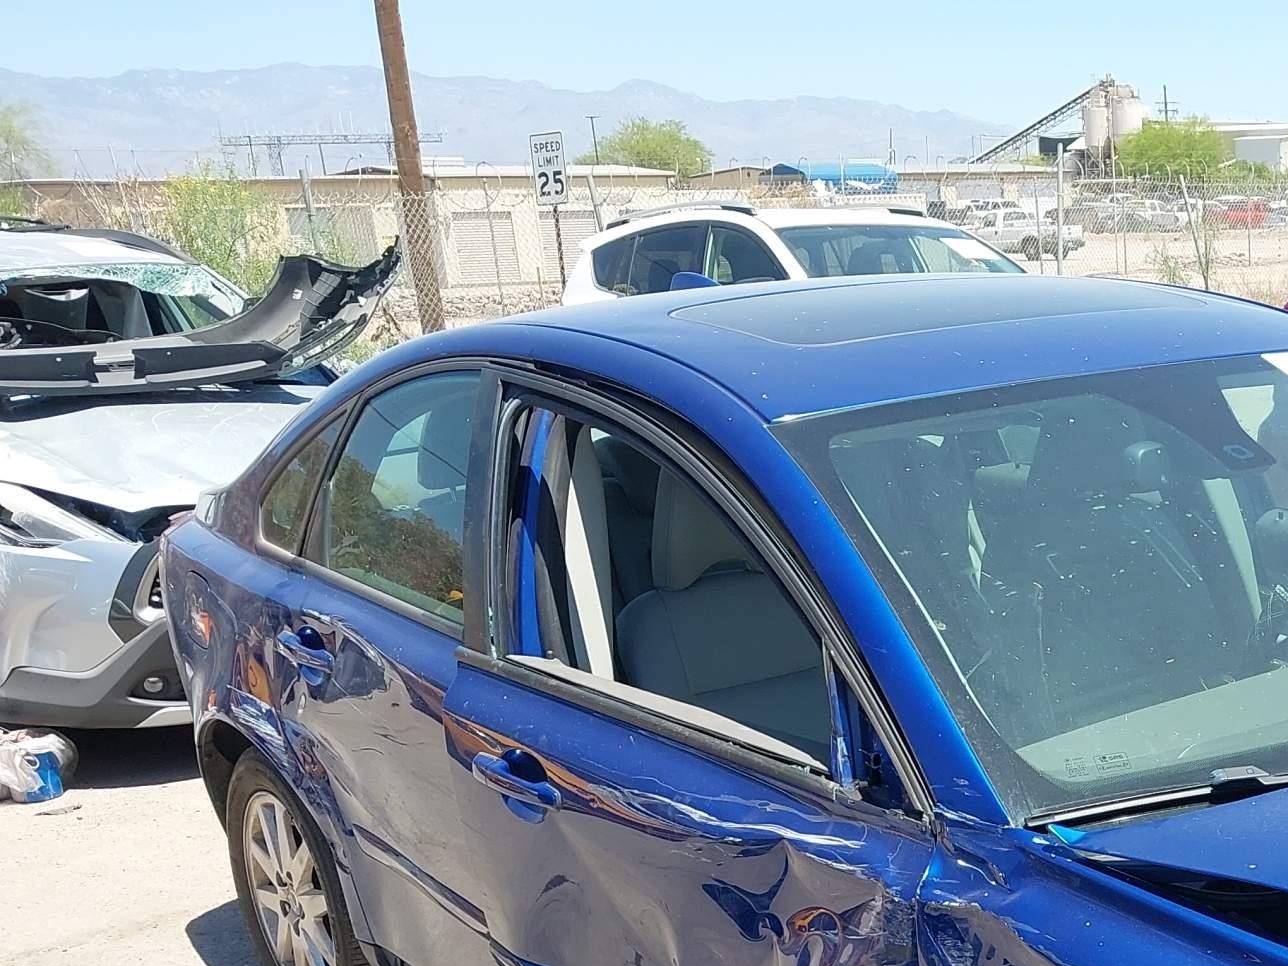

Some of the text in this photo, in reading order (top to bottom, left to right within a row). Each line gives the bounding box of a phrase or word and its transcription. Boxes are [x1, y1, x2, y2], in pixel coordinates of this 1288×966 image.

[533, 141, 561, 153] SPEED
[537, 155, 559, 168] LIMIT
[537, 170, 564, 197] 25
